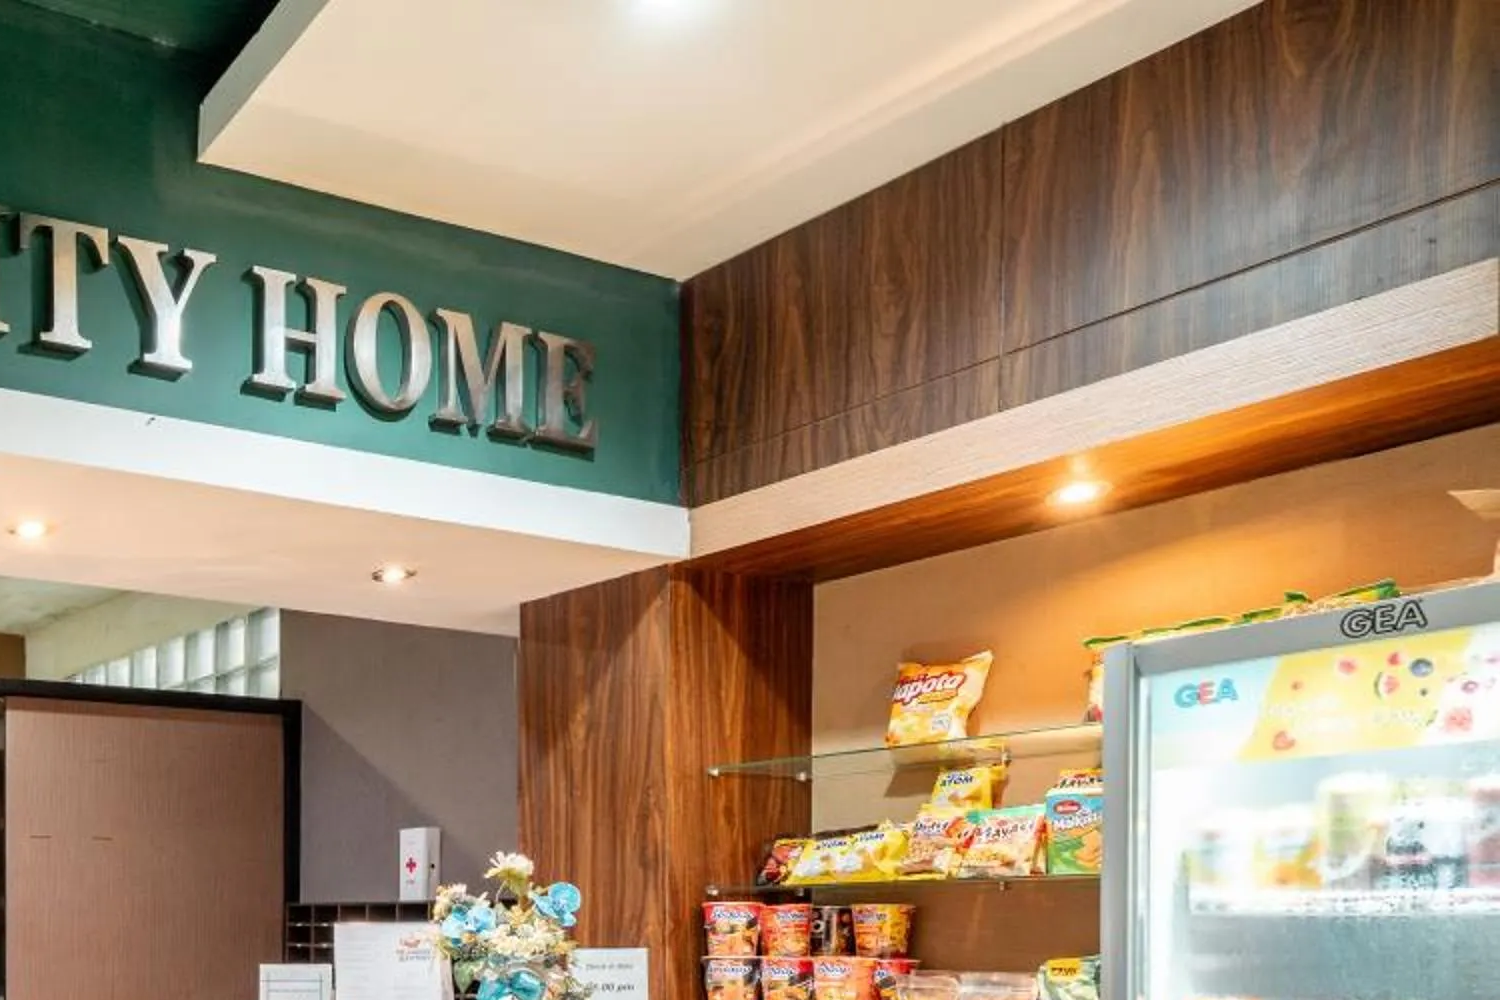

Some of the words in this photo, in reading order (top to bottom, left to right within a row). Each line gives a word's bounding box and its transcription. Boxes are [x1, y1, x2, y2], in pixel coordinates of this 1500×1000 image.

[245, 264, 597, 456] HOME
[1340, 599, 1427, 639] GEA
[1173, 677, 1240, 709] GEA
